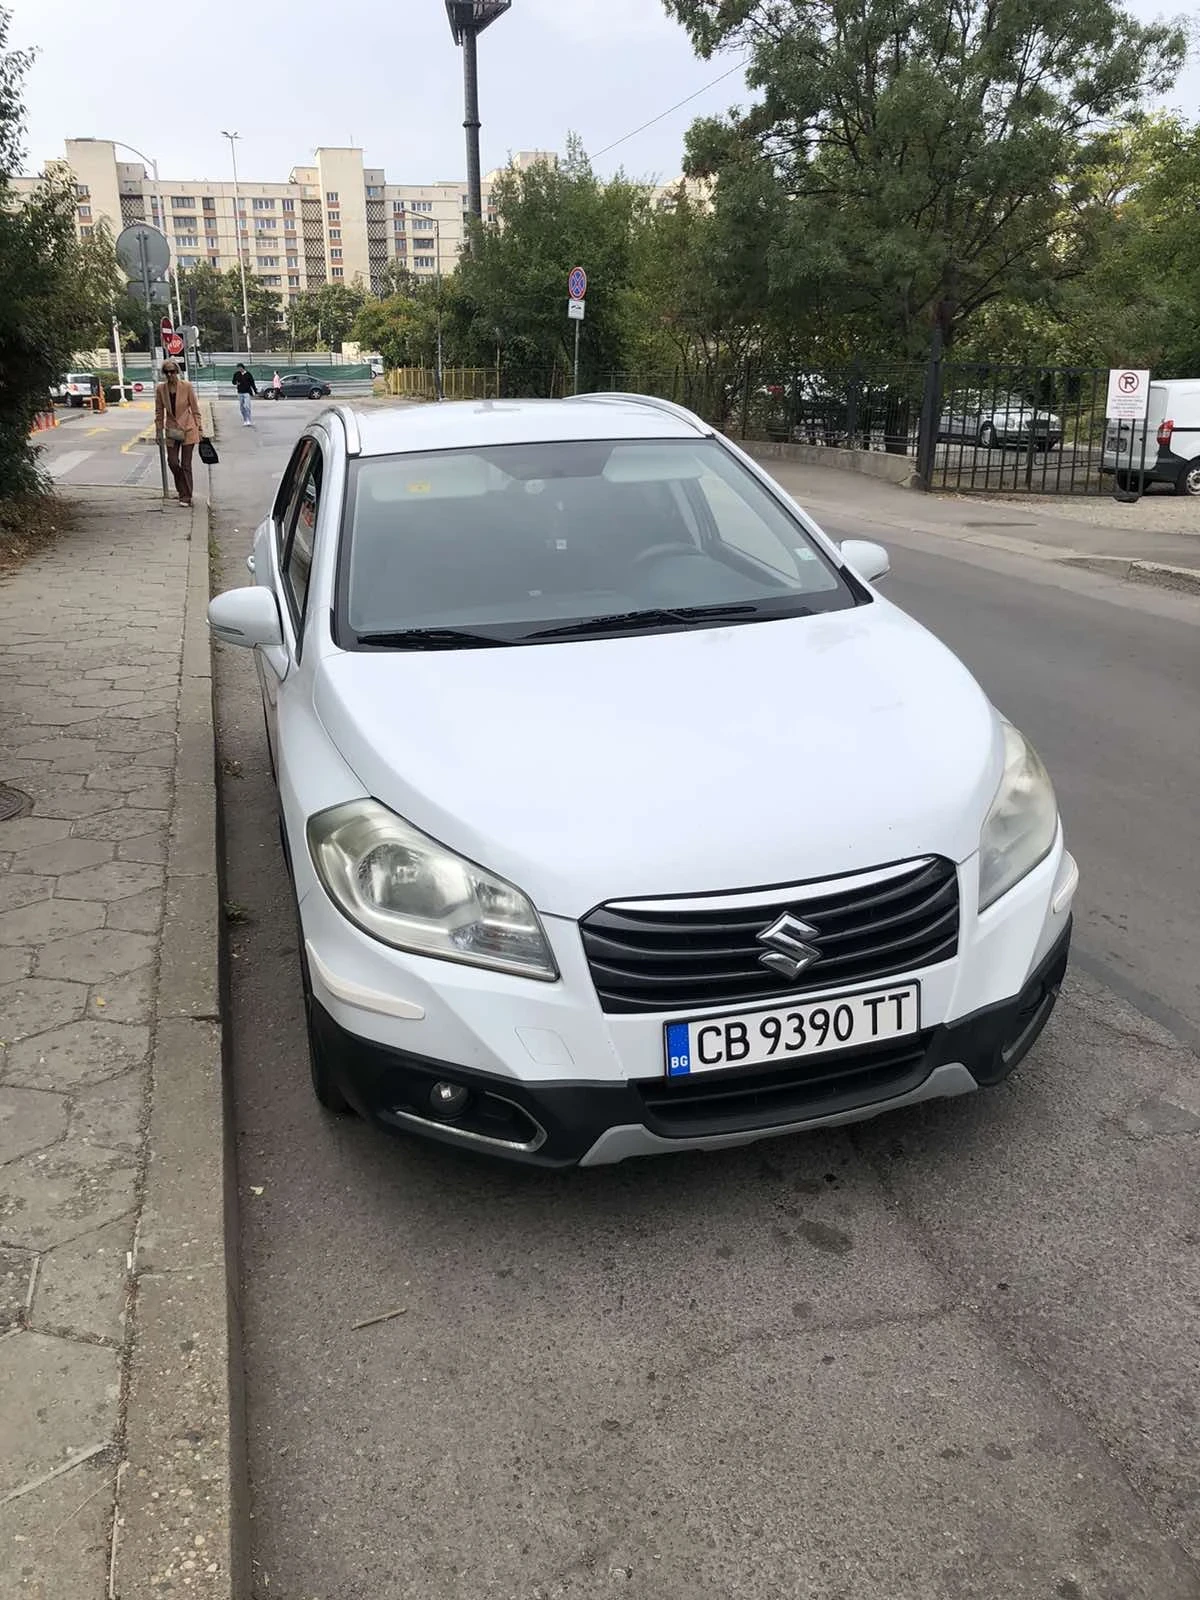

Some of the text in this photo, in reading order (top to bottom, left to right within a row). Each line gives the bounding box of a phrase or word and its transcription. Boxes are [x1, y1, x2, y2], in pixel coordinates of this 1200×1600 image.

[697, 991, 910, 1064] CB 9390 TT
[671, 1056, 688, 1068] BG
